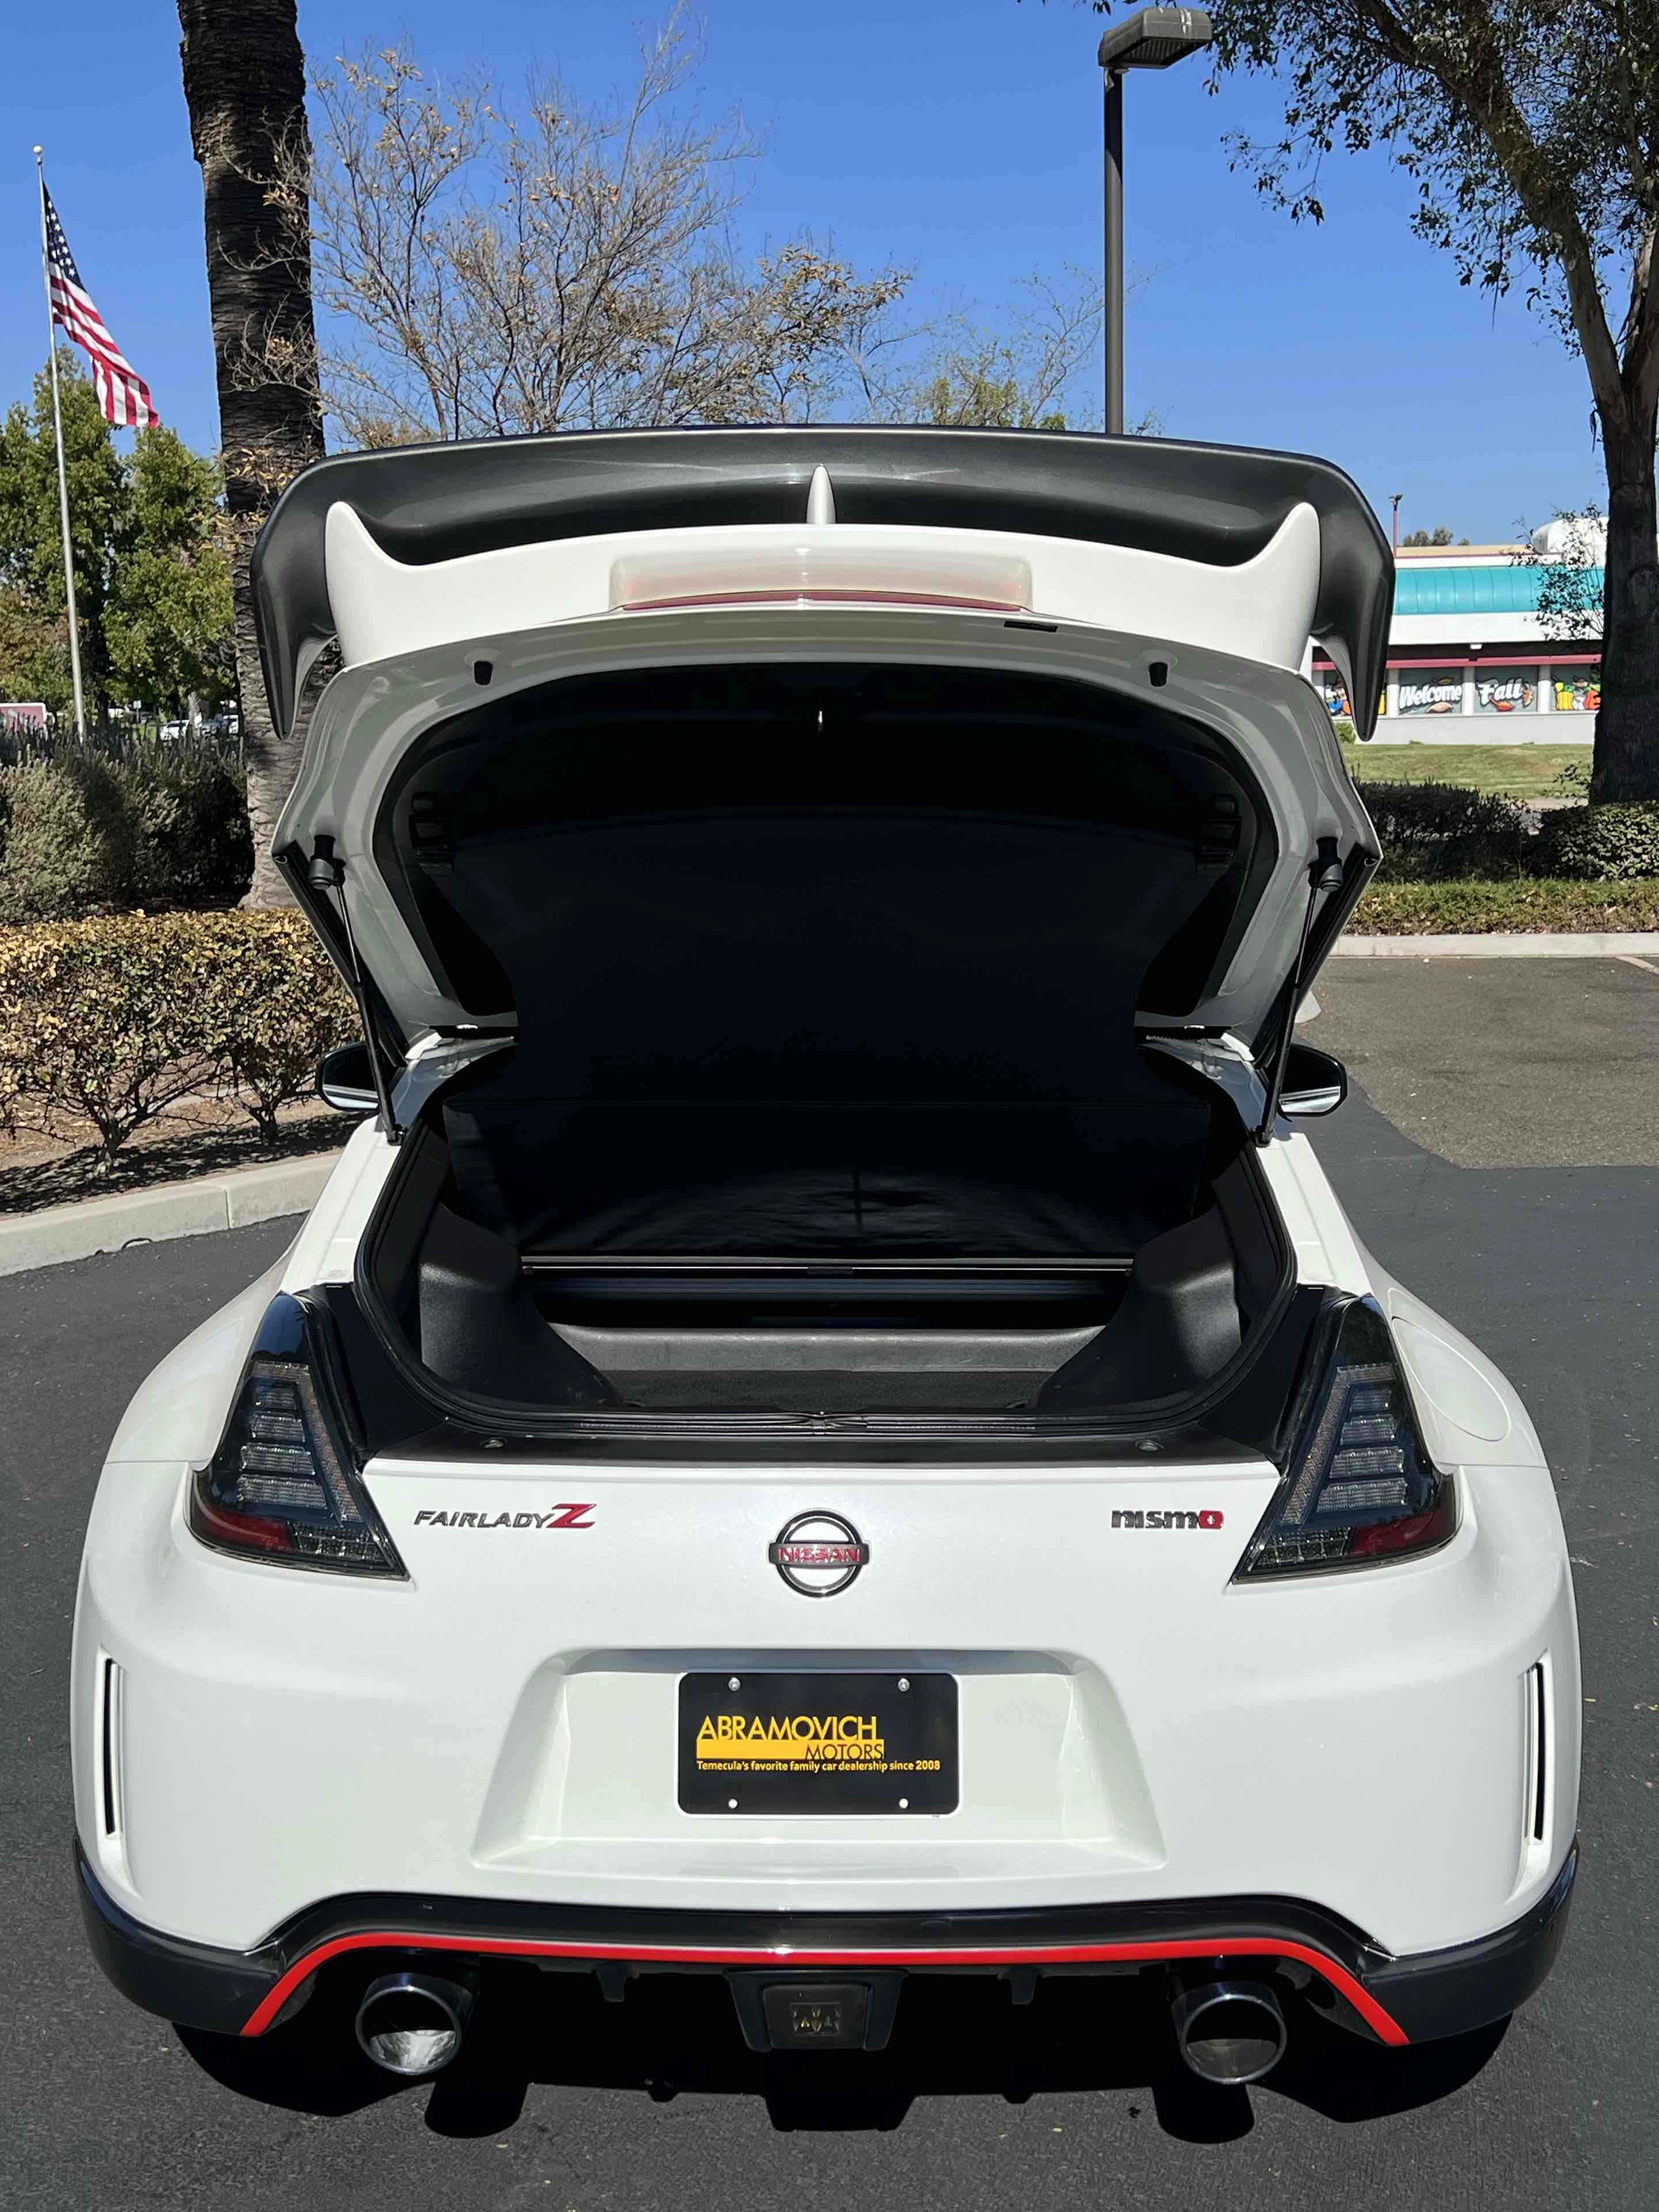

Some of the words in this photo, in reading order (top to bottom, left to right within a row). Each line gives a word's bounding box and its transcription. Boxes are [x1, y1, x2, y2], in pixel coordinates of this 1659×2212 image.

[1399, 684, 1462, 707] Welcome
[1476, 678, 1524, 705] Fall
[779, 1548, 861, 1563] NISSAN
[697, 1715, 877, 1740] ABRAMOVICH
[805, 1744, 883, 1760] MOTORS
[697, 1760, 749, 1771] Temecula's
[751, 1760, 788, 1771] favorite
[790, 1760, 820, 1774] family
[822, 1763, 836, 1771] car
[838, 1760, 888, 1773] dealership
[889, 1760, 914, 1771] since
[916, 1760, 941, 1771] 2008
